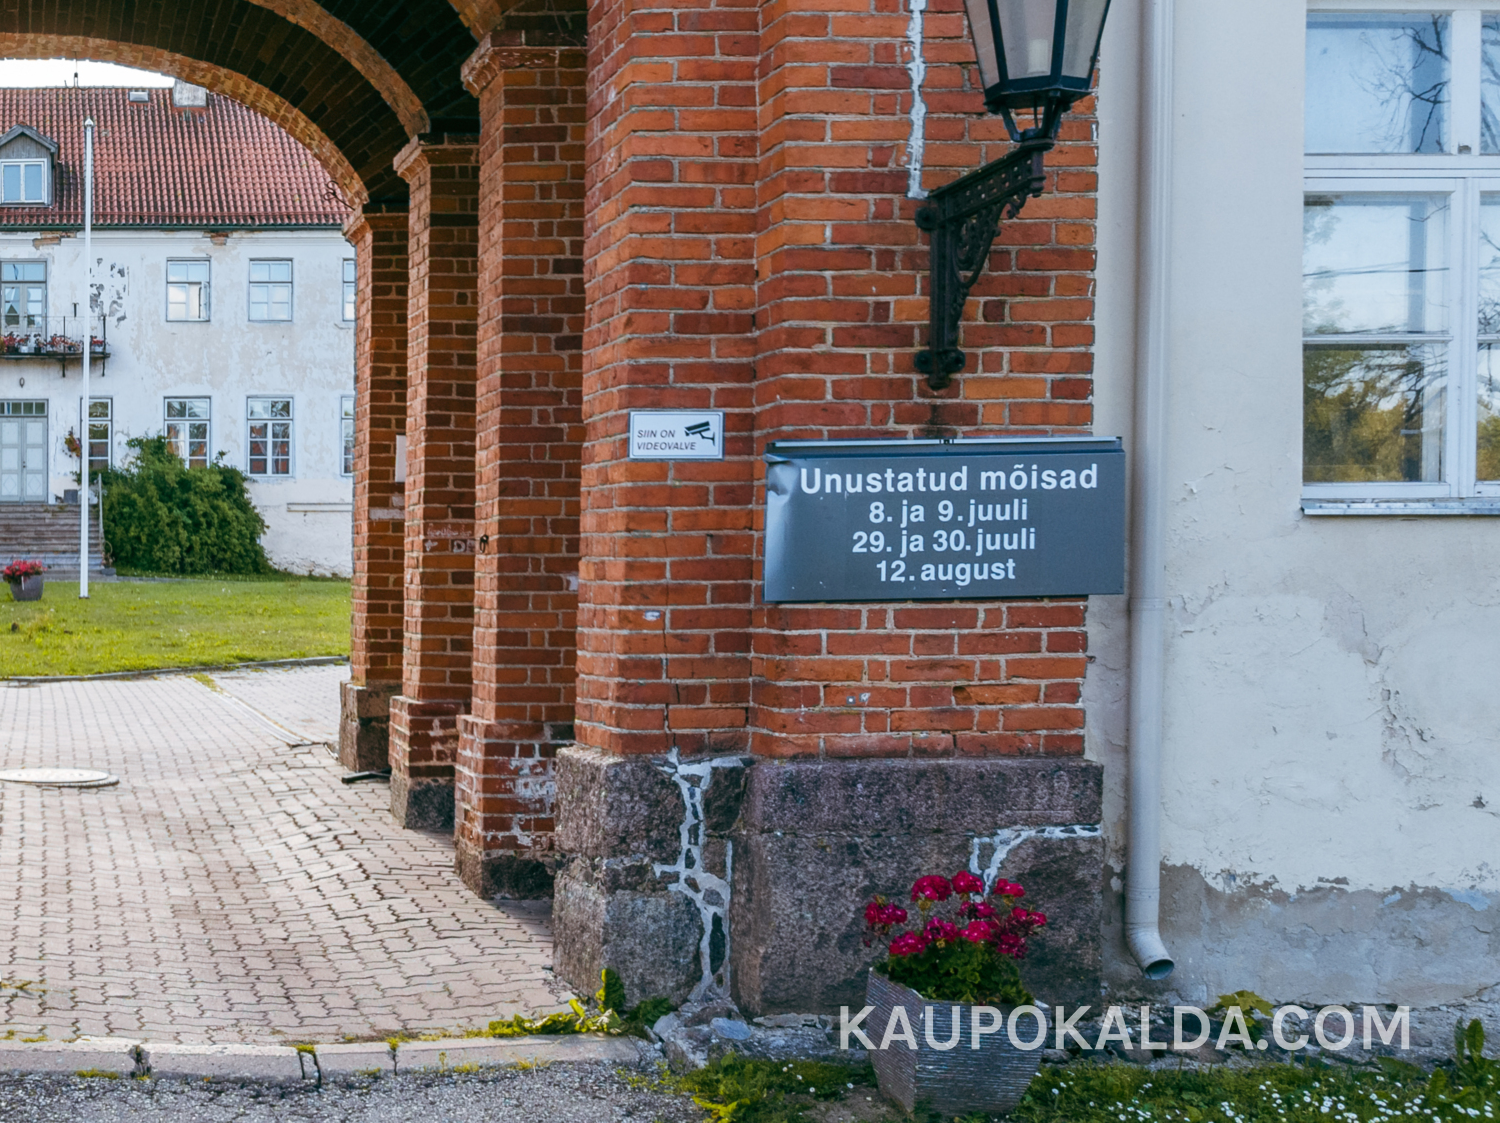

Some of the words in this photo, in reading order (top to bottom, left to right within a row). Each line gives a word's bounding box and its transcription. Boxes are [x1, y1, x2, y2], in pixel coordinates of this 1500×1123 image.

[637, 429, 657, 438] SIIN
[660, 429, 676, 438] ON
[637, 441, 697, 451] VIDEOVALVE
[800, 465, 968, 494] Unustatud
[980, 463, 1099, 491] mõisad
[868, 501, 893, 524] 8.
[900, 499, 925, 528] ja
[937, 499, 963, 523] 9.
[968, 498, 1029, 527] juuli
[852, 530, 892, 553] 29.
[900, 529, 925, 558] ja
[932, 529, 971, 552] 30.
[975, 527, 1036, 556] juuli
[876, 560, 915, 583] 12.
[920, 558, 1016, 586] august
